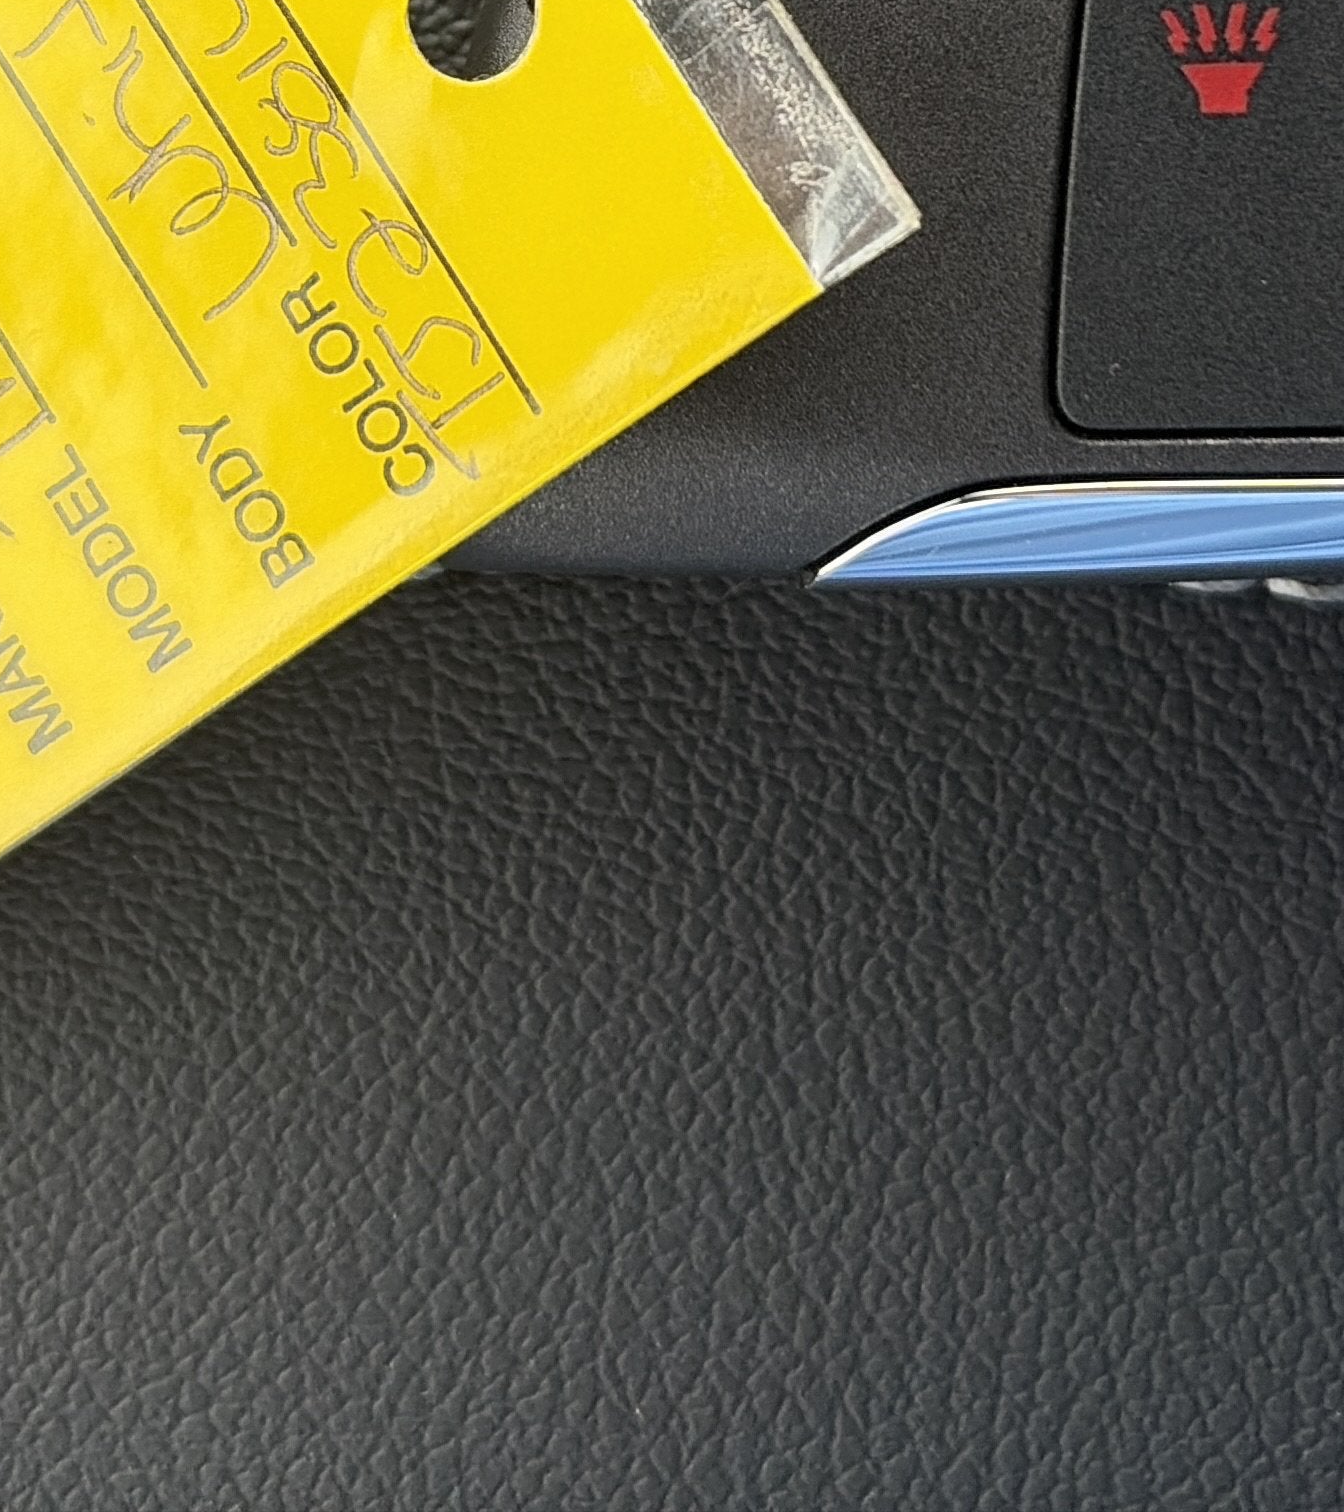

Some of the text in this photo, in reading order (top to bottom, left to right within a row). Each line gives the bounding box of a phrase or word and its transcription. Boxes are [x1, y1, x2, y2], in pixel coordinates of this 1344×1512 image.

[277, 270, 433, 493] COLOR
[40, 440, 193, 671] MODEL
[176, 411, 317, 587] BODY
